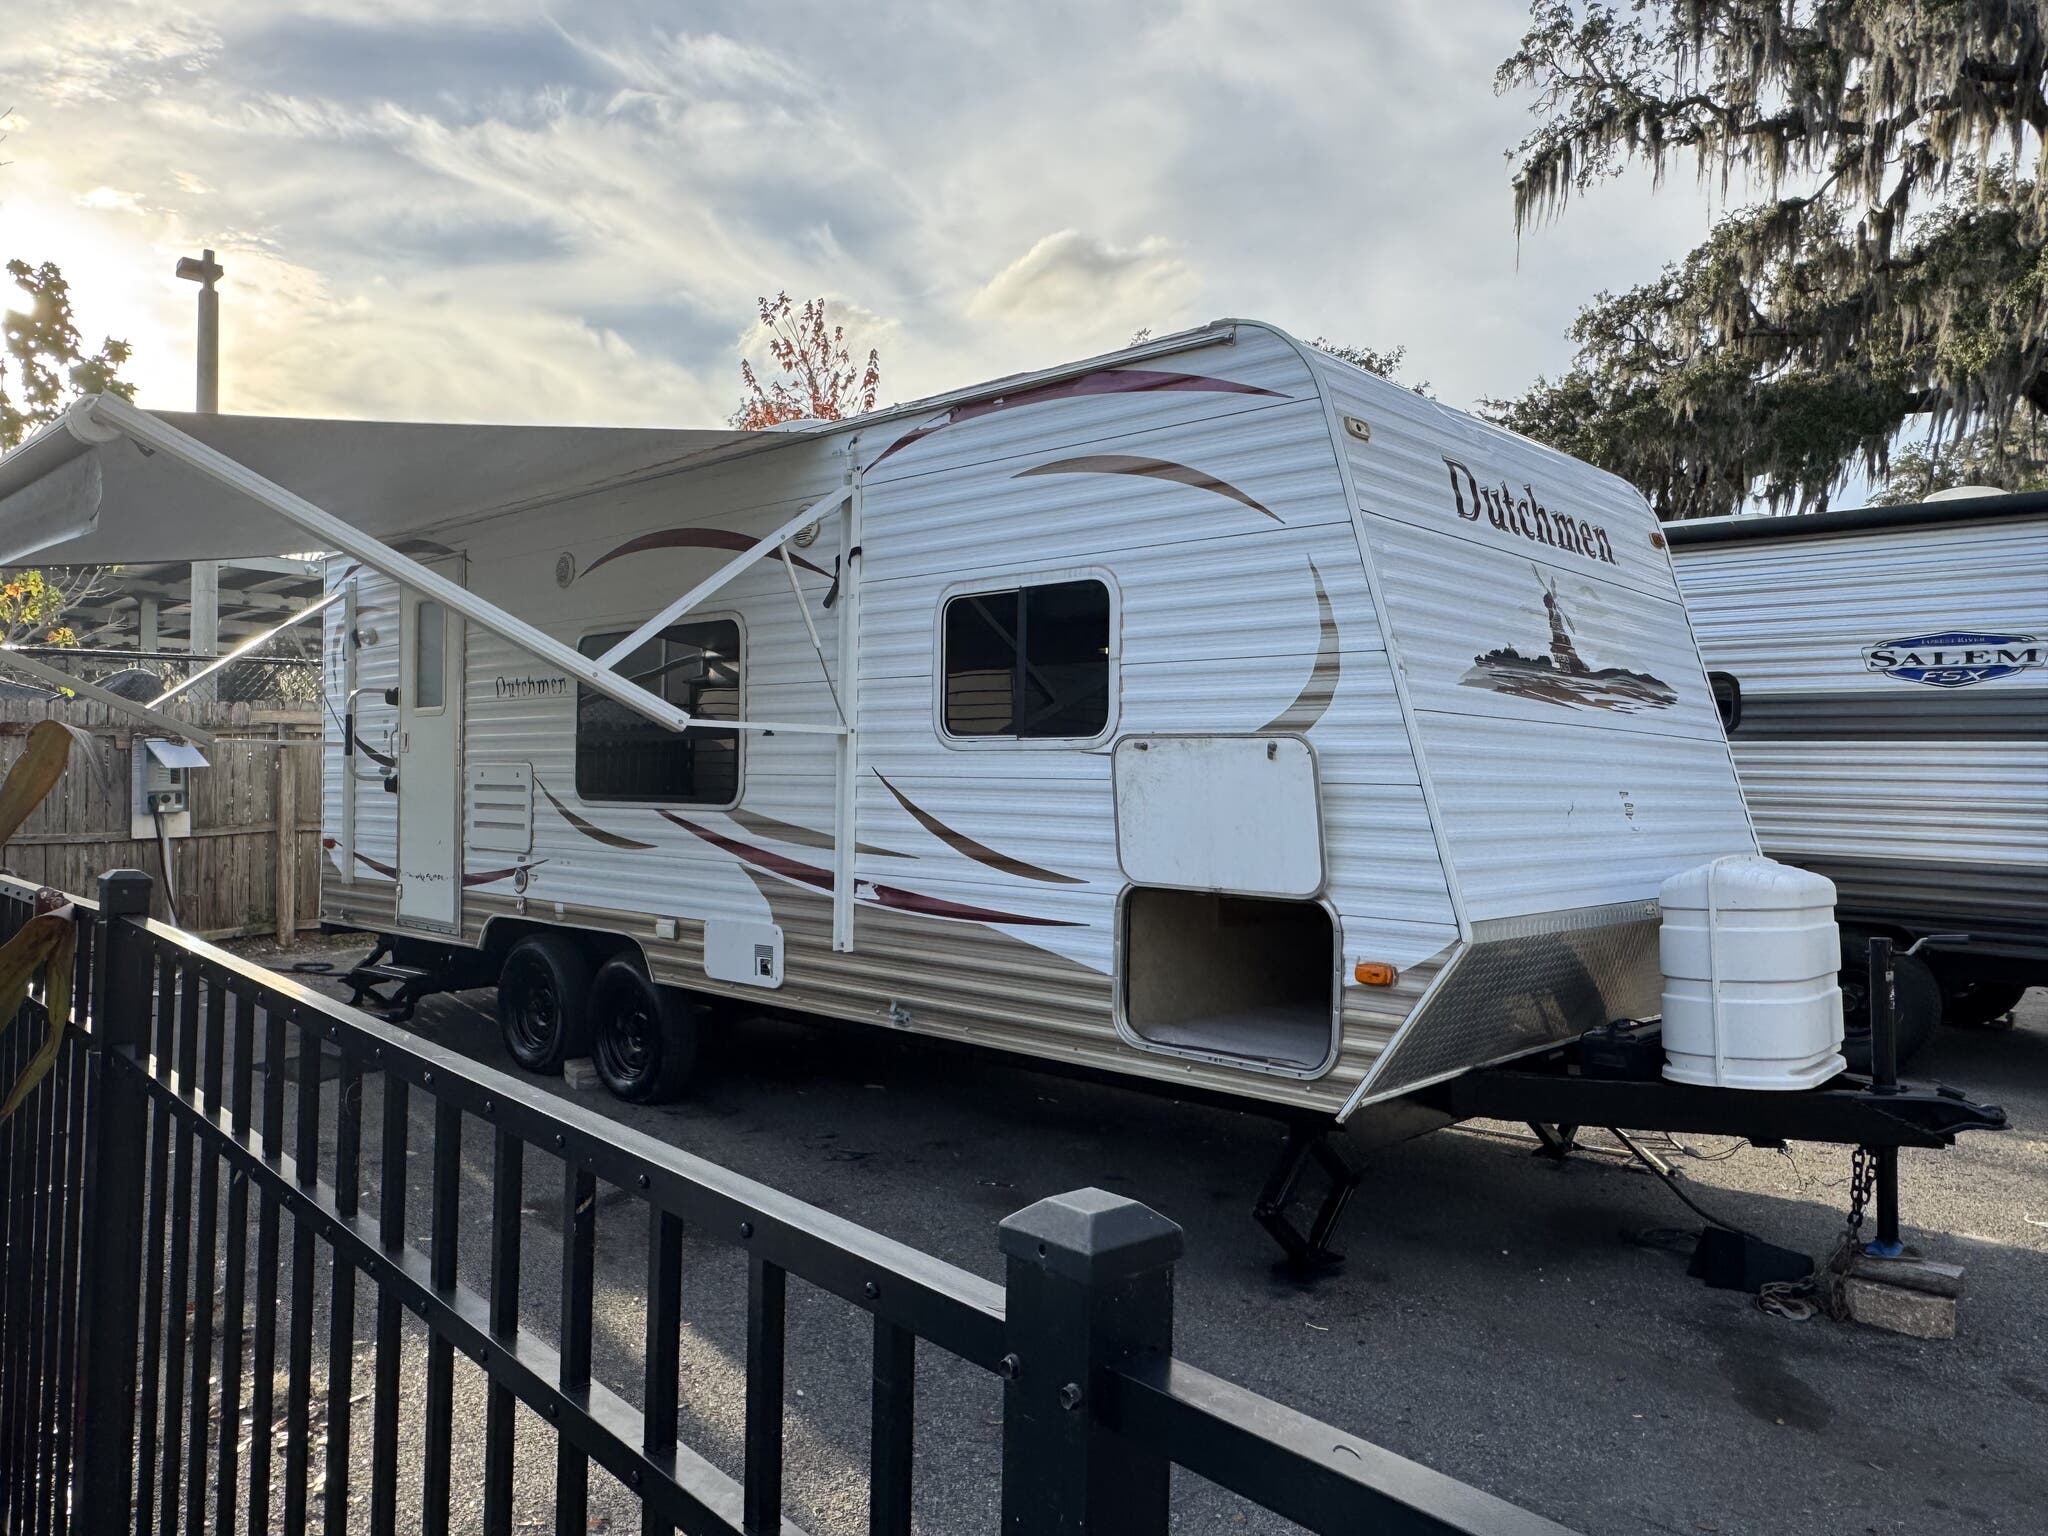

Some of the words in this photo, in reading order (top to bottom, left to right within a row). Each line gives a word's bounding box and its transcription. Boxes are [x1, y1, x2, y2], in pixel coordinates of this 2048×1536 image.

[1441, 455, 1616, 566] Dutchmen
[1870, 648, 2042, 667] SALEM
[495, 675, 566, 698] Dutchmen
[1920, 670, 1989, 683] FSX
